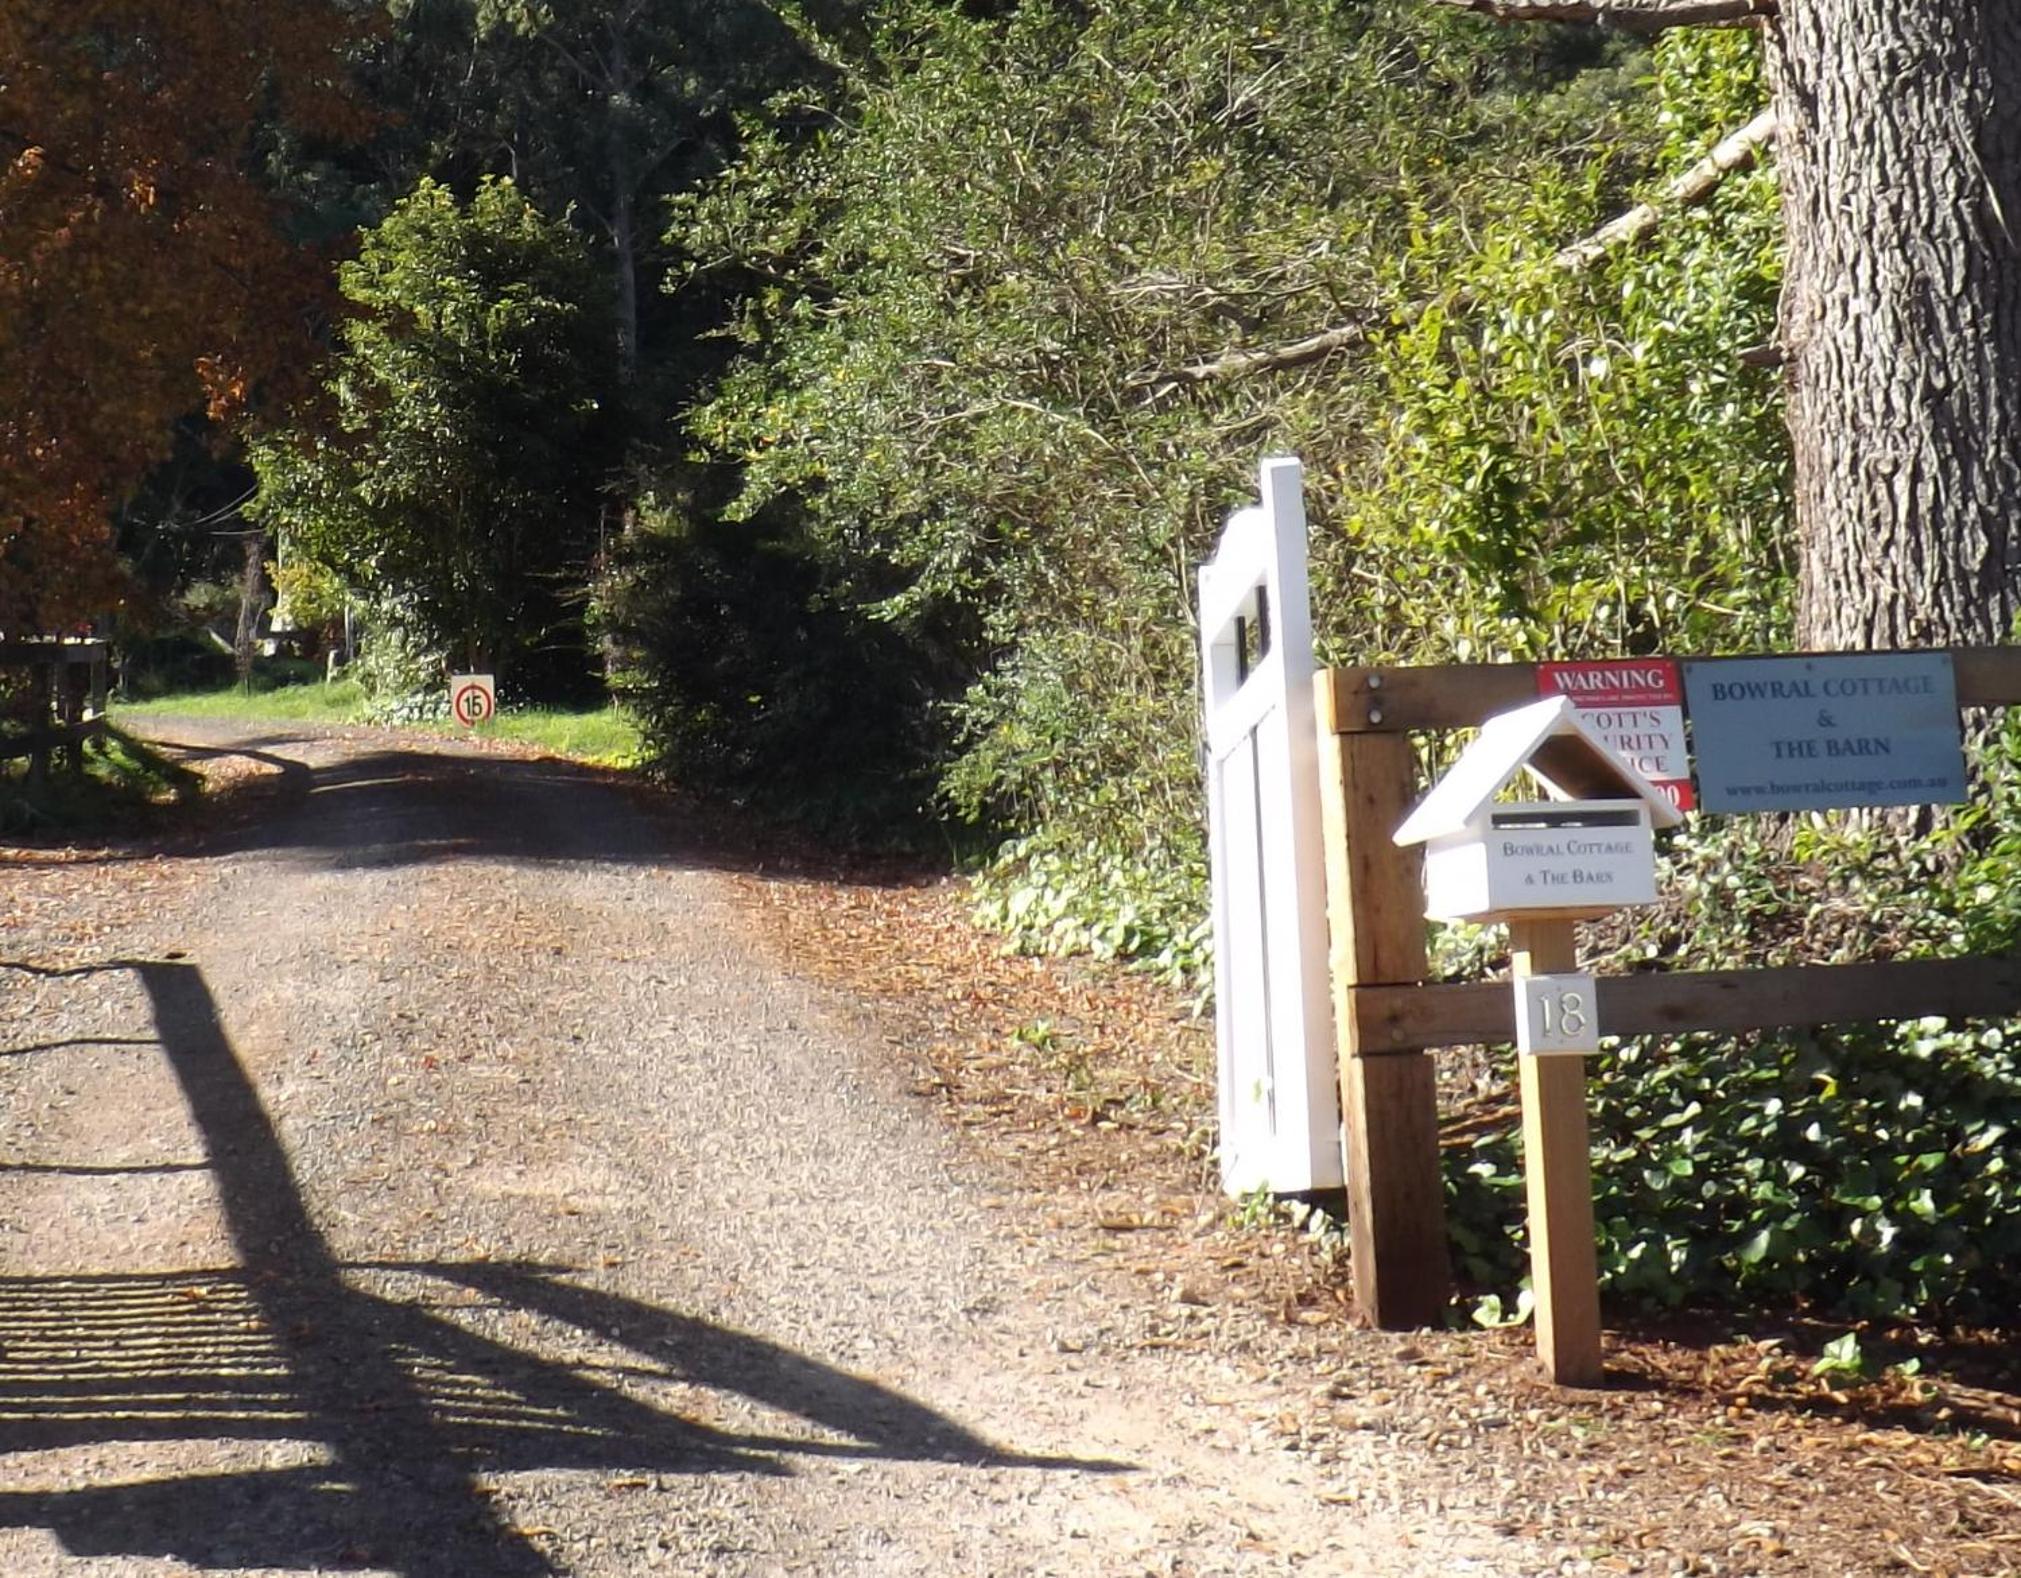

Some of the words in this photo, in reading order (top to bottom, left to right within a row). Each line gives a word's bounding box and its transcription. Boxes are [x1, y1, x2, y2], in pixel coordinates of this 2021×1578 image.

[1553, 668, 1665, 691] WARNING
[1712, 680, 1815, 701] BOWRAL
[1823, 675, 1936, 697] COTTAGE
[463, 694, 482, 717] 15
[1817, 708, 1836, 728] &
[1773, 739, 1817, 759] THE
[1826, 736, 1891, 757] BARN
[1725, 776, 1947, 797] www.bowralcottage.com.au
[1503, 841, 1564, 857] BOWRAL
[1567, 839, 1635, 855] COTTAGE
[1524, 873, 1535, 885] &
[1540, 869, 1569, 885] THE
[1572, 868, 1614, 885] BARN
[1539, 992, 1587, 1038] 18
